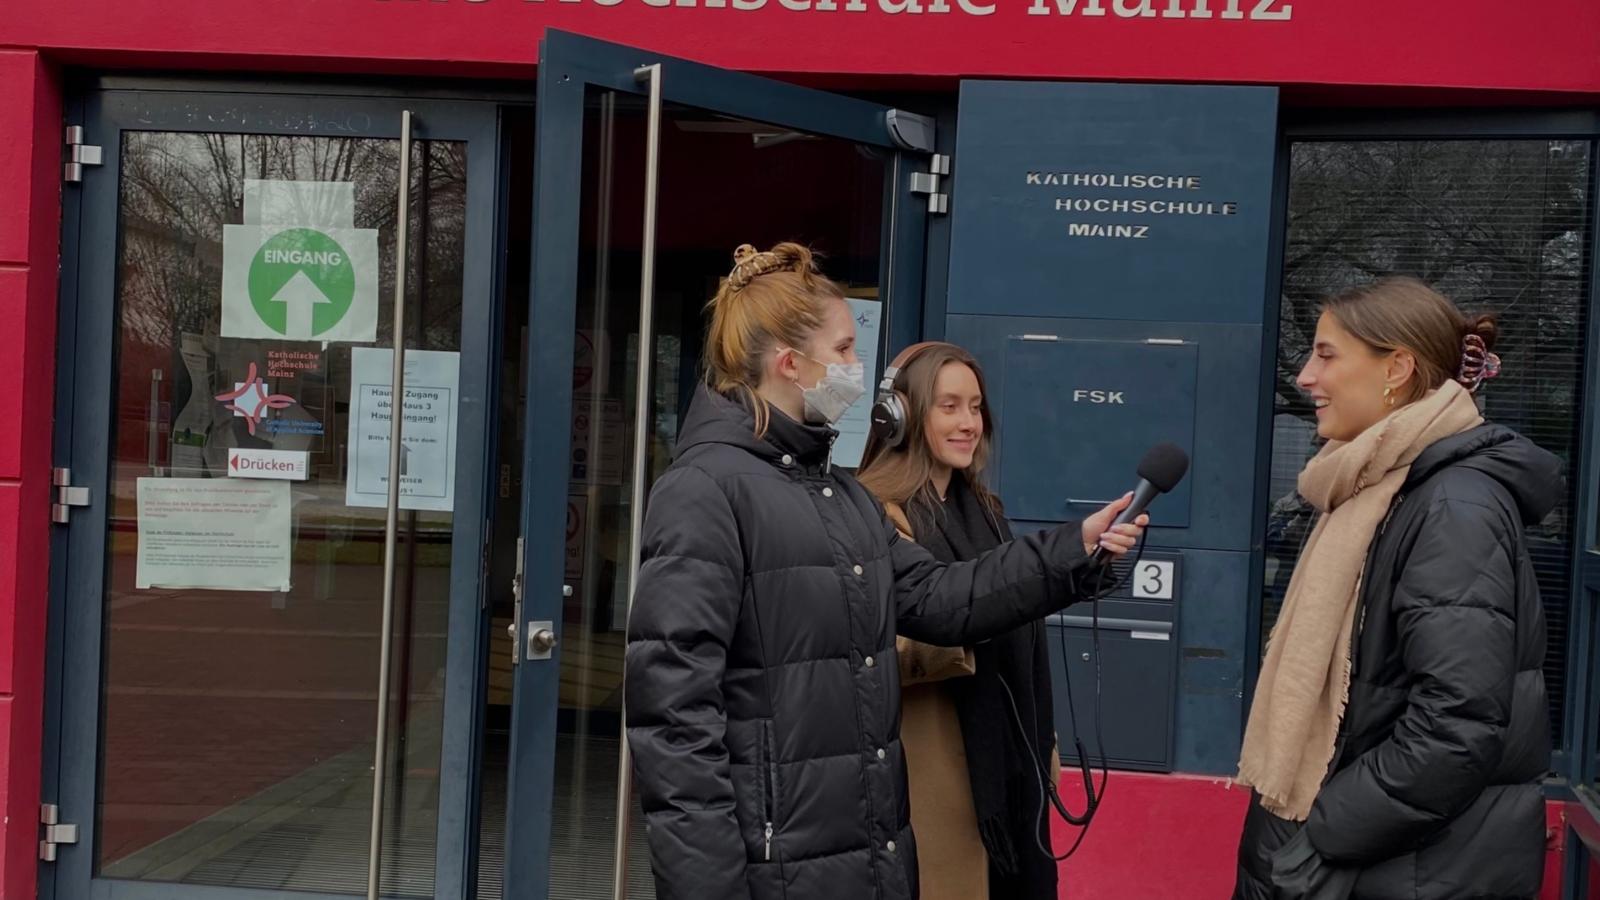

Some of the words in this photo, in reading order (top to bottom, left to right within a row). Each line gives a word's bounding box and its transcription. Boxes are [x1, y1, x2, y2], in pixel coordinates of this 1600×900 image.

[1025, 171, 1201, 190] KATHOLISCHE
[1055, 197, 1238, 215] HOCHSCHULE
[1068, 223, 1150, 239] MAINZ
[264, 249, 342, 266] EINGANG
[268, 351, 319, 360] Katholische
[268, 360, 318, 369] Hochschule
[405, 390, 439, 400] Zugang
[1073, 389, 1124, 404] FSK
[240, 457, 294, 471] Drücken
[1142, 564, 1163, 595] 3
